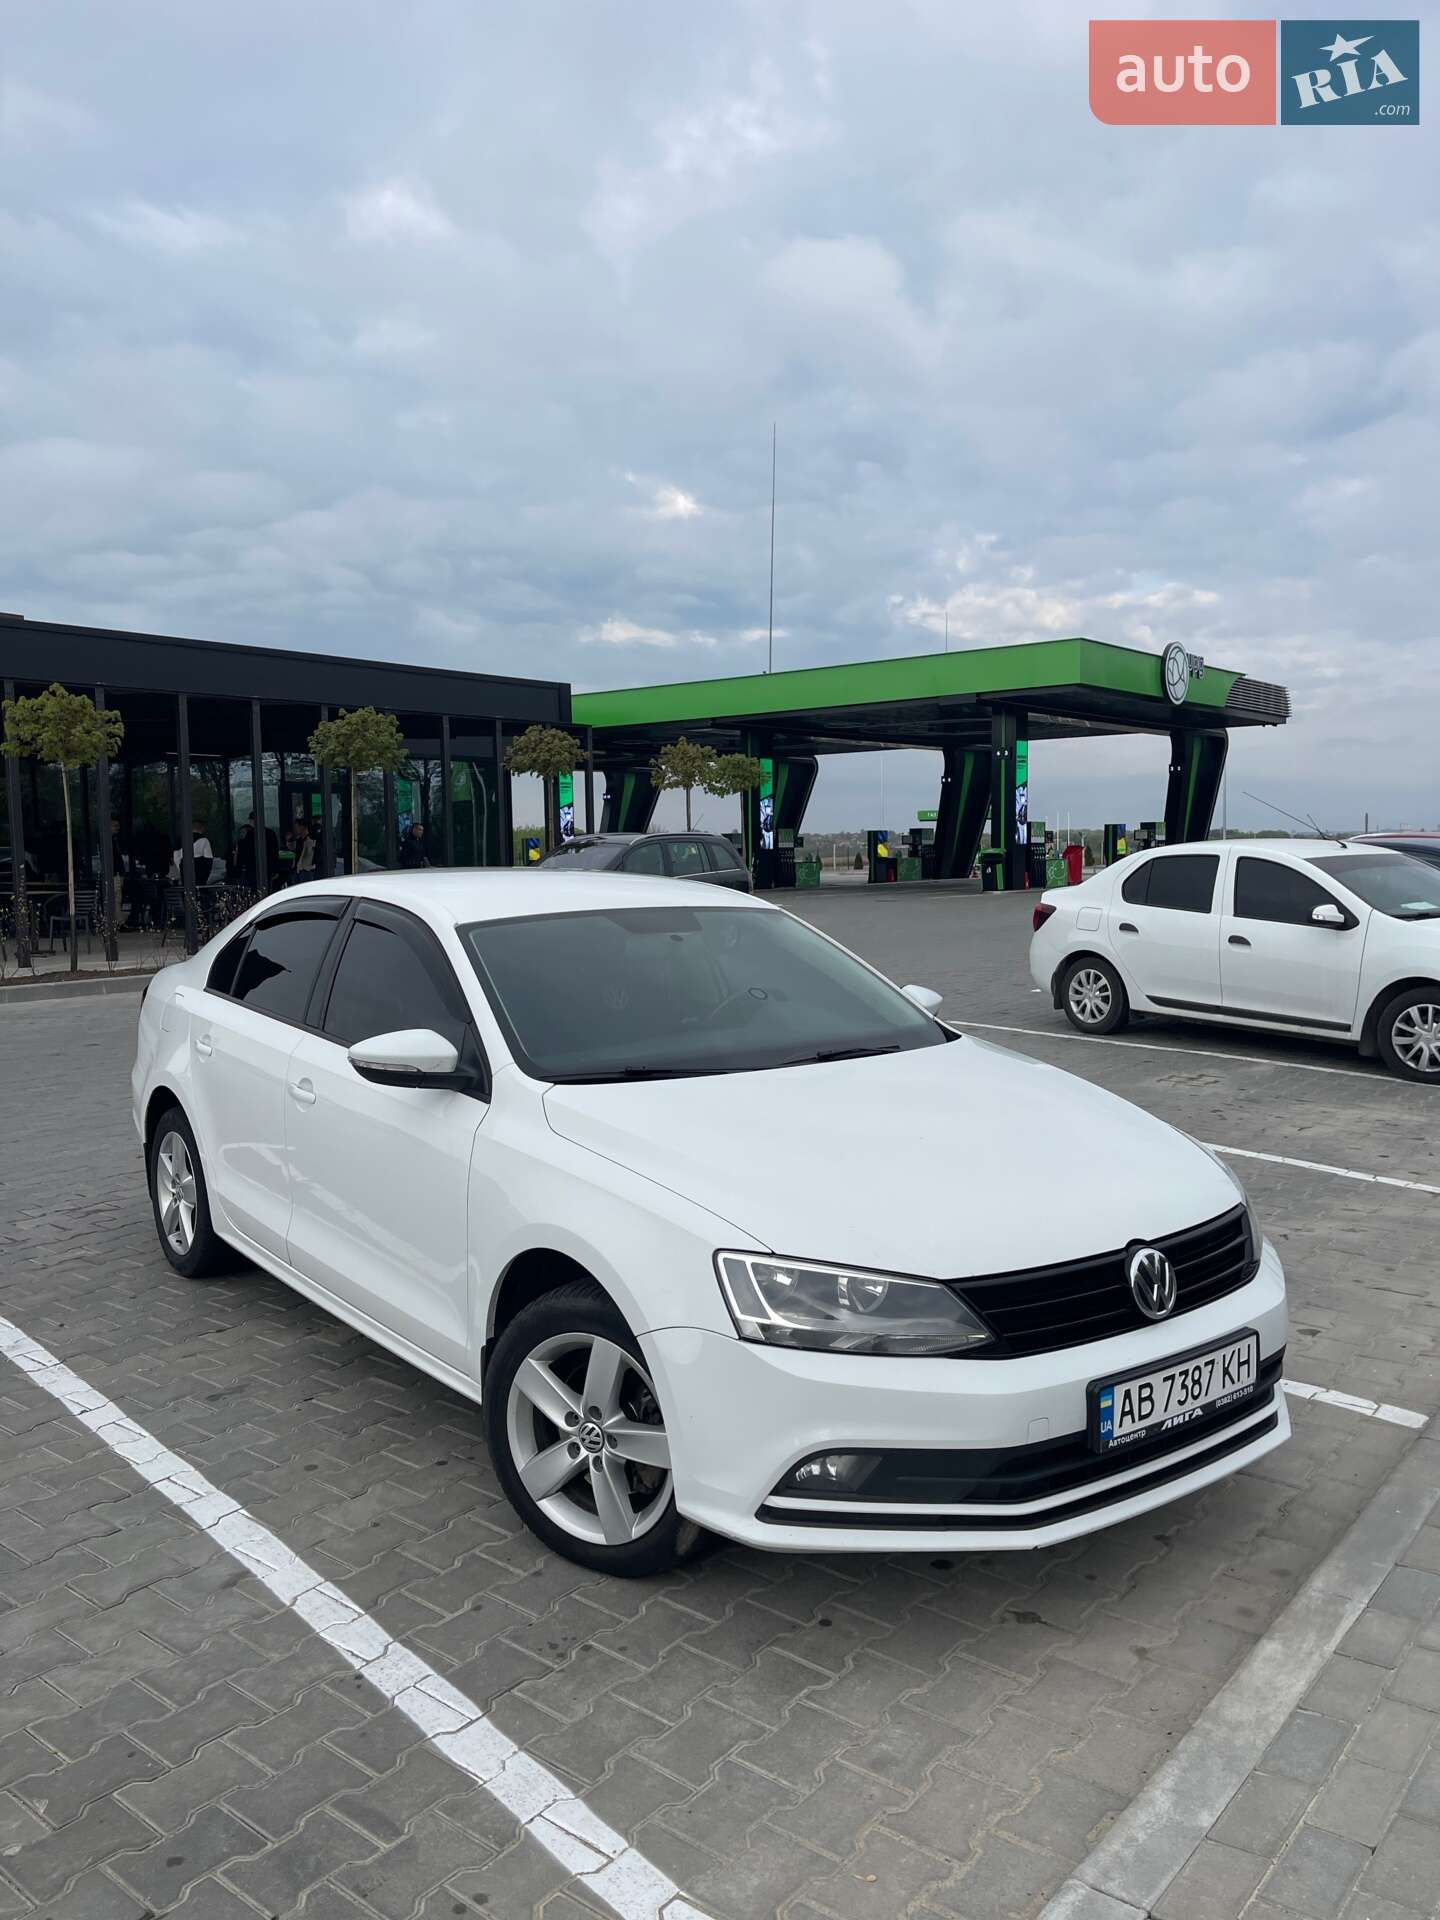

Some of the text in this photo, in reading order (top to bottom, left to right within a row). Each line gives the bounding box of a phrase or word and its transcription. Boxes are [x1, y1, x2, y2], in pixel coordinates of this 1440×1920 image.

[1118, 1344, 1251, 1429] AB 7387 KH
[1100, 1420, 1112, 1433] UA
[1161, 1407, 1203, 1431] ЛИГА
